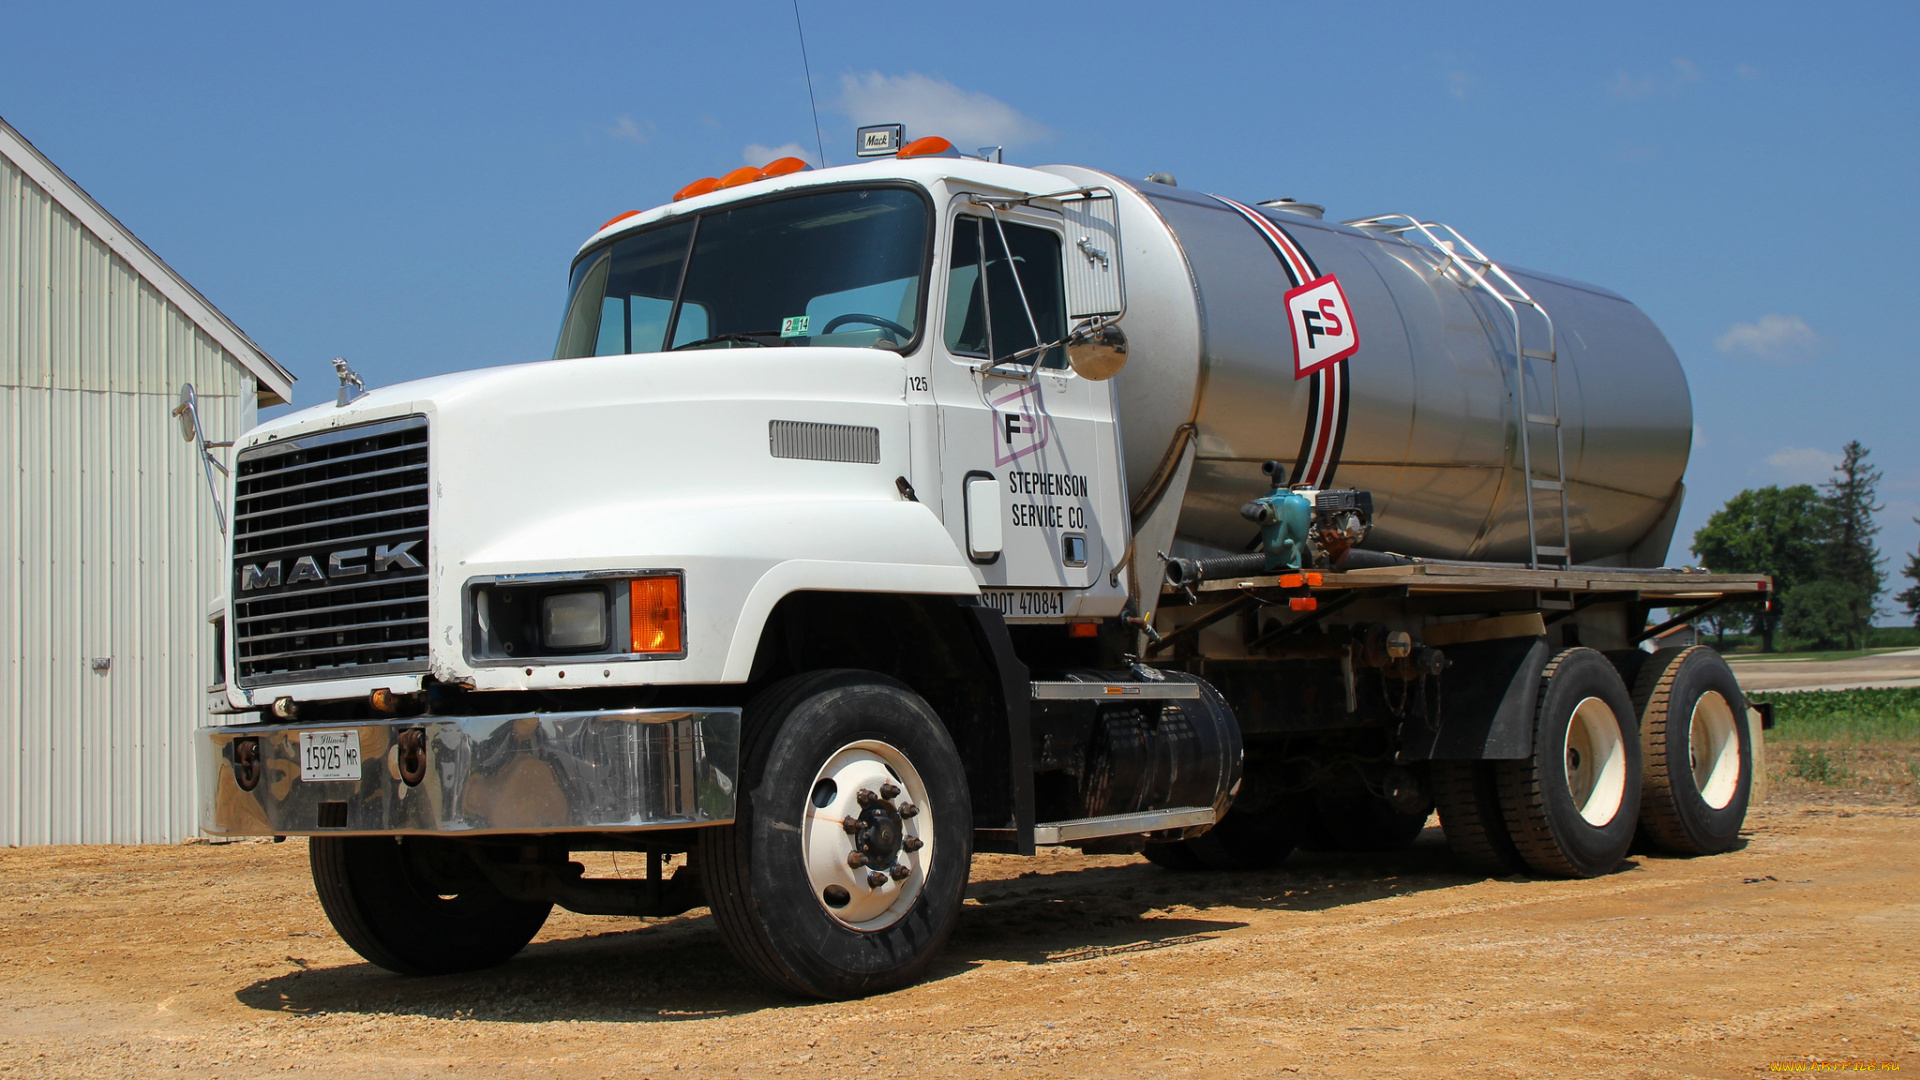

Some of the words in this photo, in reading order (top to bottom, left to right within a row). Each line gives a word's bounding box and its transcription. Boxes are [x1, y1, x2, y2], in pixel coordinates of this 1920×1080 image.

[865, 134, 888, 147] Mack
[784, 319, 793, 332] 2
[799, 317, 809, 331] 14
[1302, 298, 1343, 349] FS
[909, 376, 928, 392] 125
[1009, 470, 1088, 498] STEPHENSON
[1012, 503, 1063, 529] SERVICE
[1068, 506, 1088, 530] CO.
[242, 539, 425, 592] MACK
[1019, 591, 1065, 615] 470841
[306, 745, 341, 771] 15925
